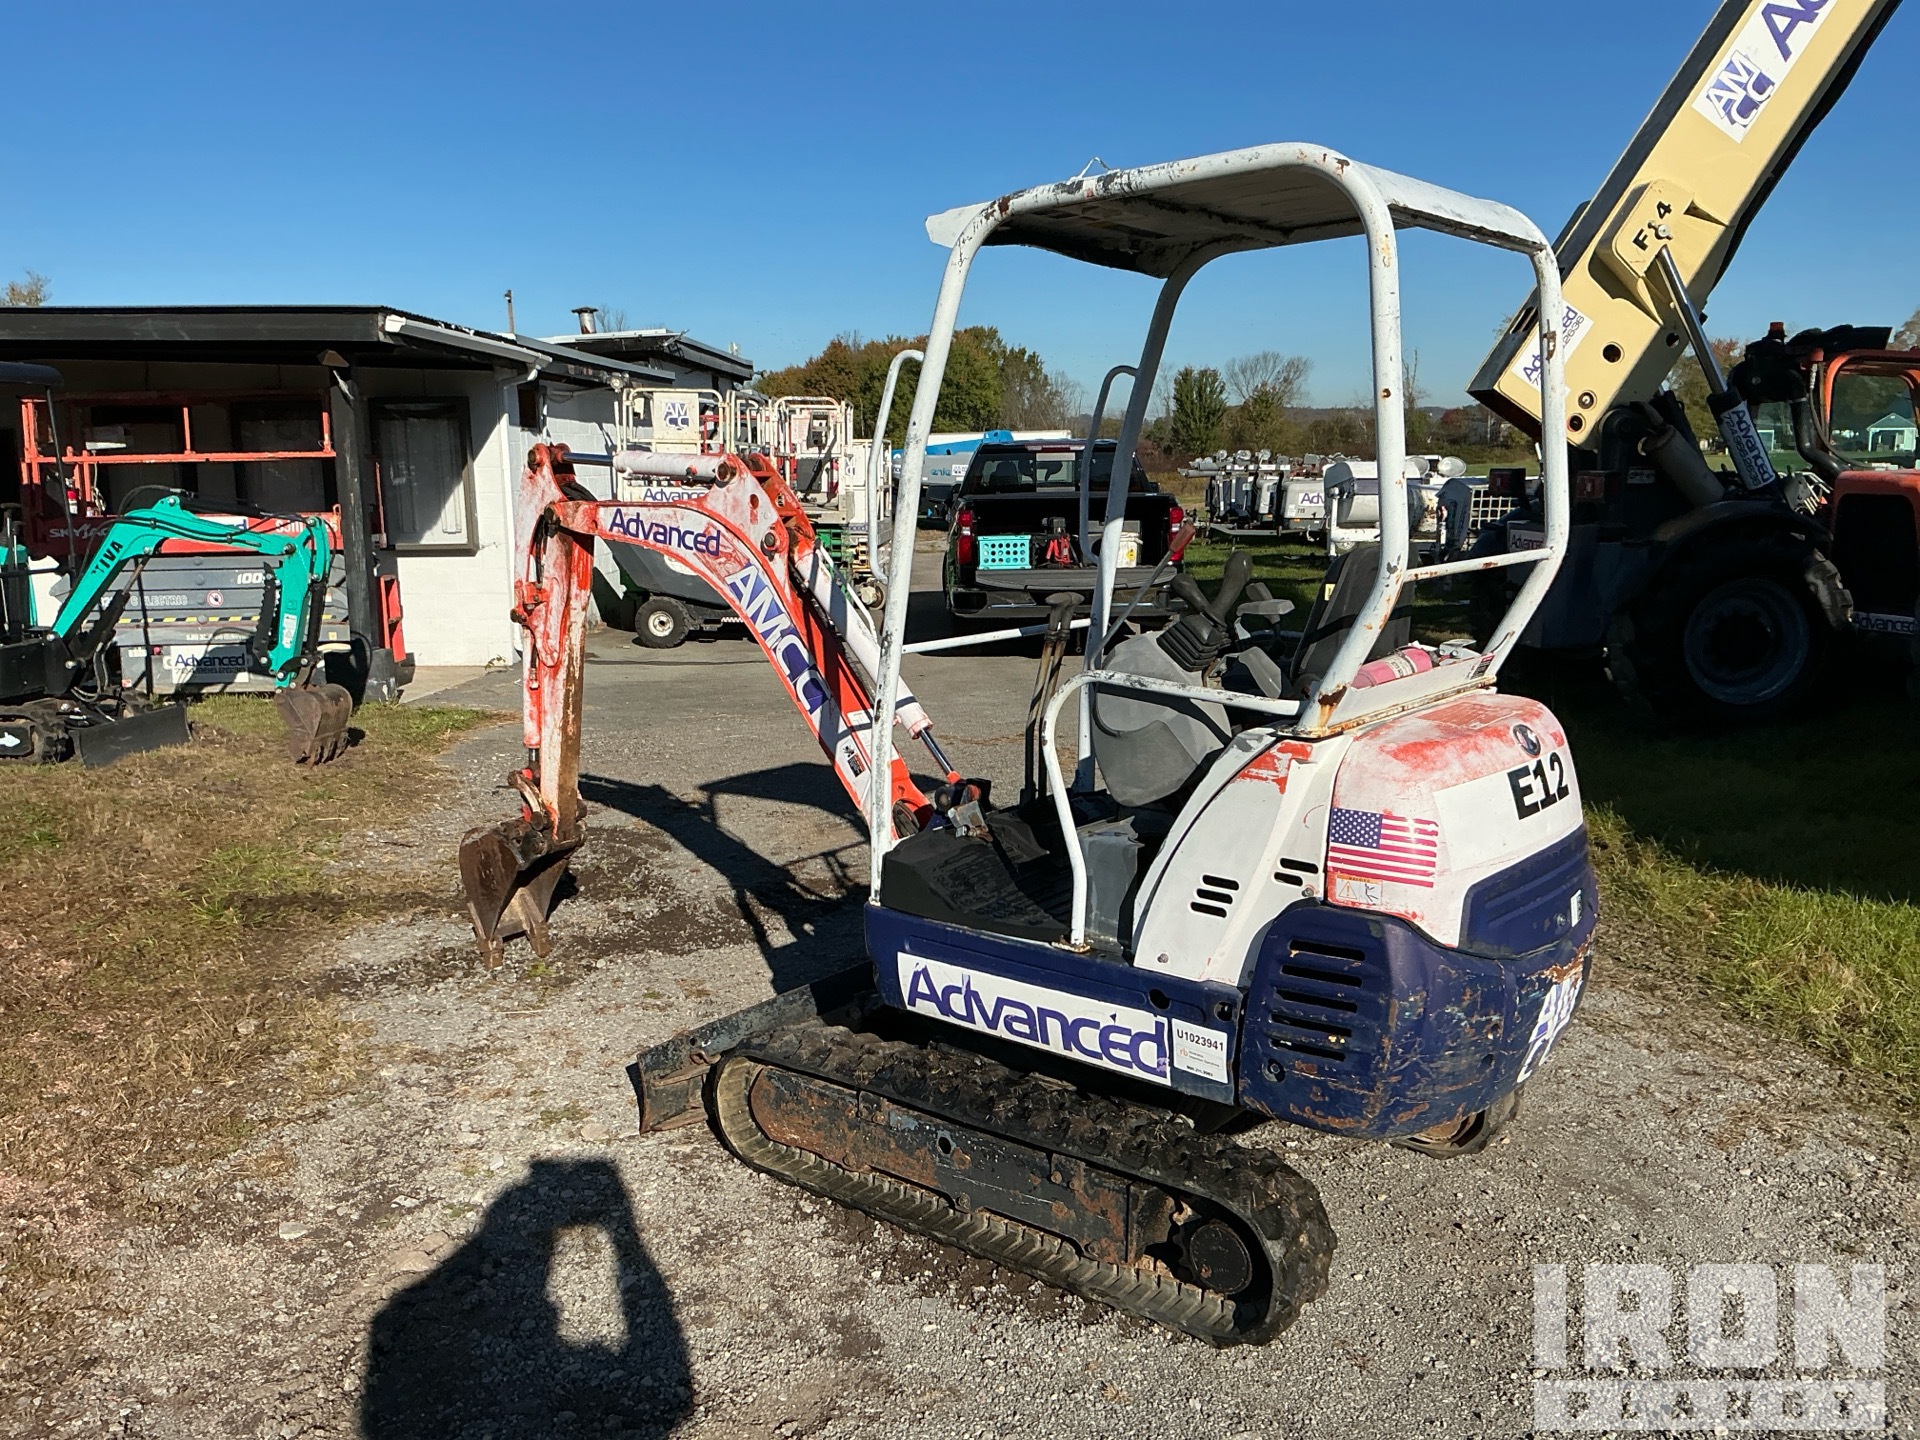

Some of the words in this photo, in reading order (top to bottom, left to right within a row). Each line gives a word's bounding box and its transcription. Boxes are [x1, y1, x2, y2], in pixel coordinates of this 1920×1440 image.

[1731, 408, 1774, 483] Advanced
[643, 488, 707, 502] Advanc
[609, 508, 721, 556] Advanced
[175, 653, 245, 667] Advanced
[1506, 752, 1570, 820] E12
[907, 962, 1168, 1078] Advanced
[1176, 1029, 1224, 1051] U1023941
